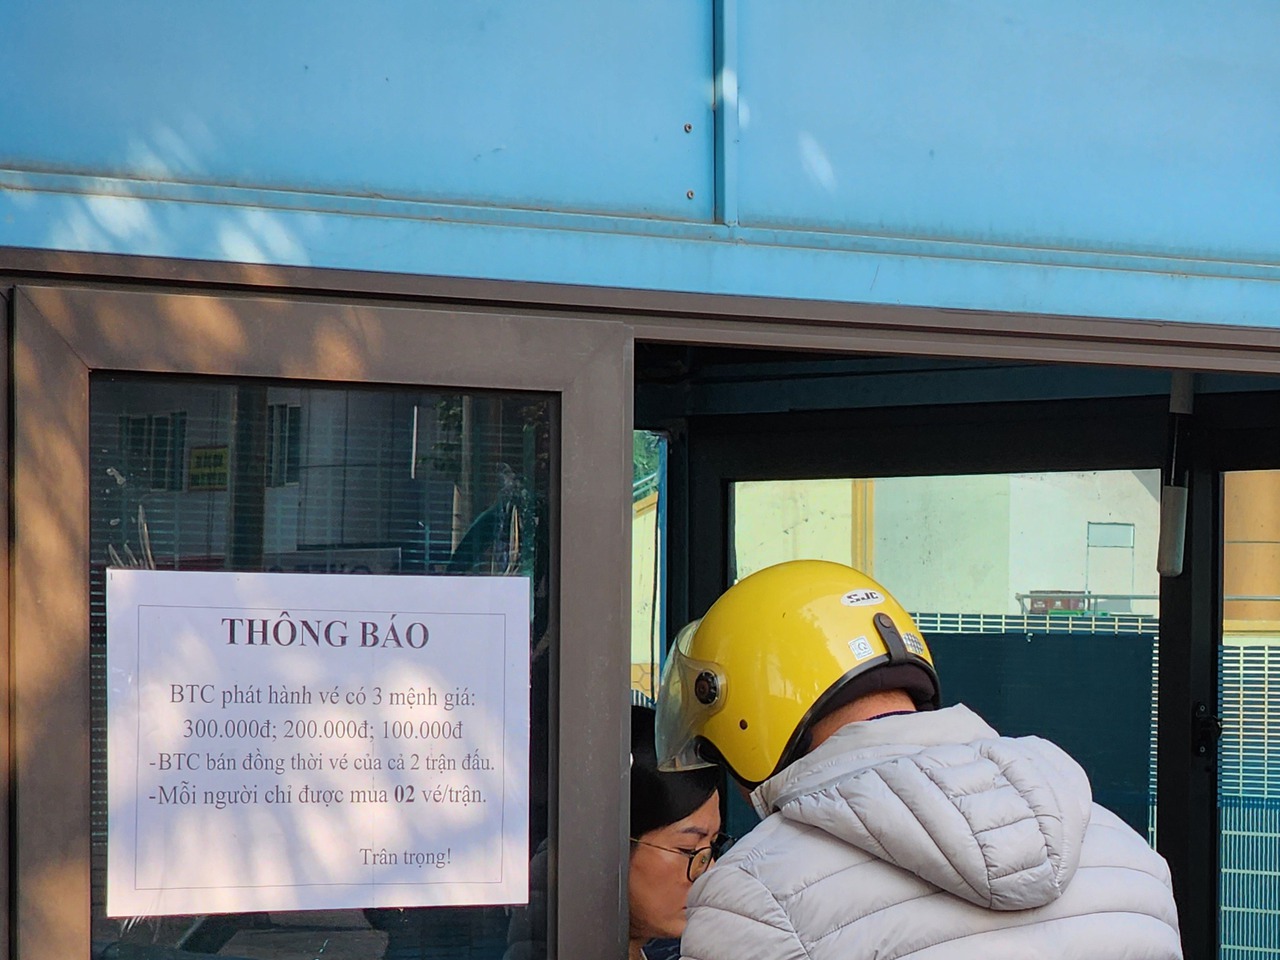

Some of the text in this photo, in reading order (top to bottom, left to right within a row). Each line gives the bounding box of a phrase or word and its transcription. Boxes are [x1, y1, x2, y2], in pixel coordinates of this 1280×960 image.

[220, 609, 430, 650] THÔNG BÁO
[169, 681, 477, 714] BTC phát hành vé có 3 mệnh giá:
[182, 716, 465, 743] 300.000đ; 200.000đ; 100.000đ
[149, 747, 495, 777] -BTC bán đồng thời vé của cả 2 trận đấu.
[148, 780, 489, 811] -Mỗi người chỉ được mua 02 vé/trận.
[357, 845, 454, 872] Trân trọng!
